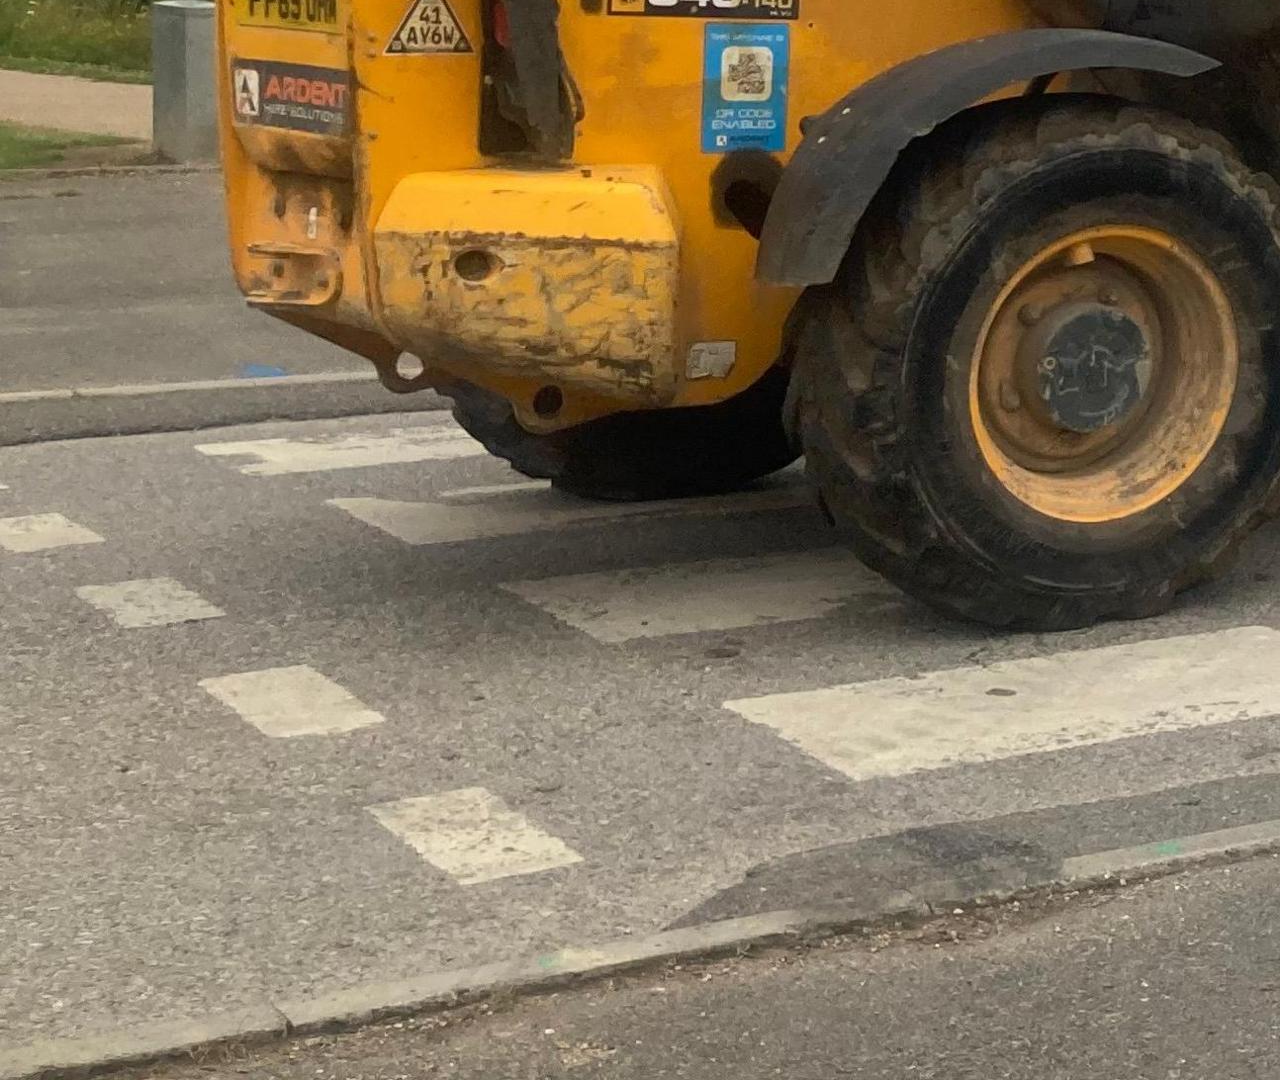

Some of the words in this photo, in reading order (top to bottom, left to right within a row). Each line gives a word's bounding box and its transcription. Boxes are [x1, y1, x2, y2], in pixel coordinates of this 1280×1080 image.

[419, 5, 442, 25] 41
[406, 25, 454, 45] AY6W
[263, 74, 346, 109] ARDENT
[711, 119, 777, 130] ENABLED
